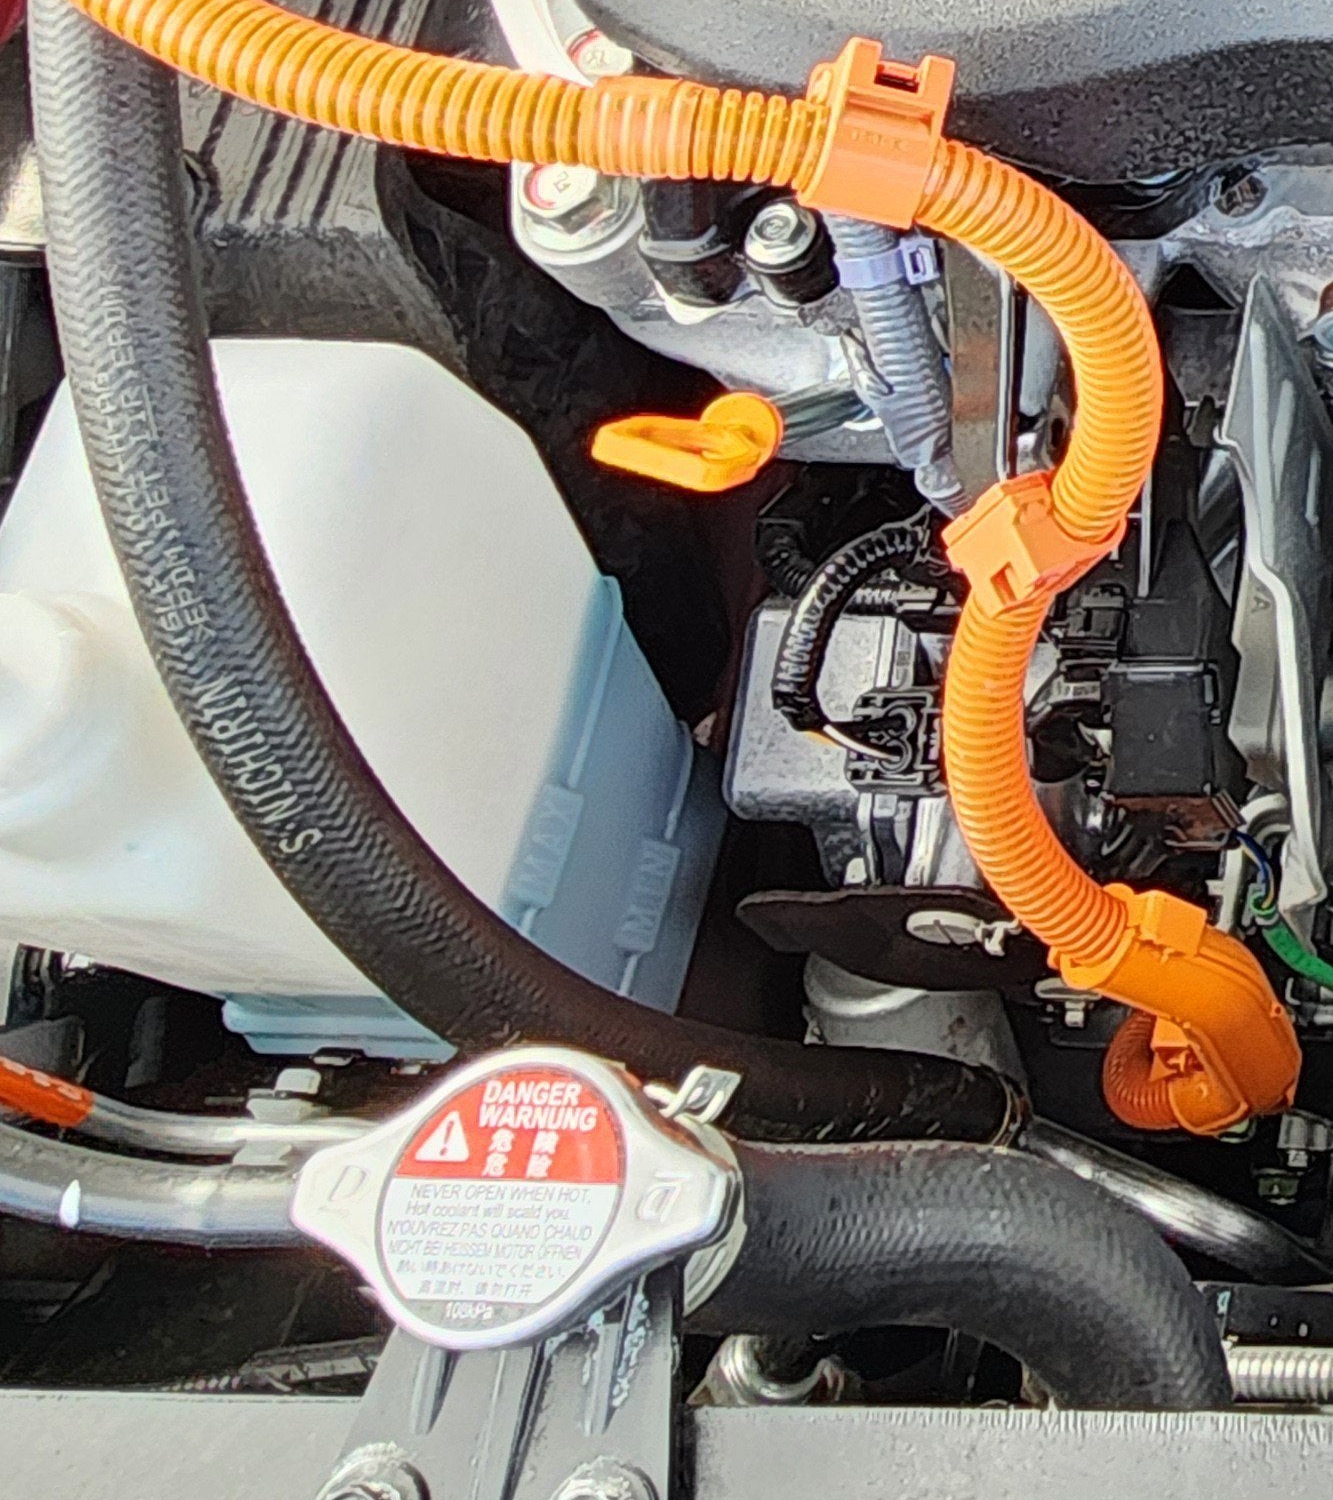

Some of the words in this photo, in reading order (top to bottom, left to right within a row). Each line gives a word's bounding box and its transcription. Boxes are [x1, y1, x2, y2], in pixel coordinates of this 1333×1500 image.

[483, 1080, 582, 1106] DANGER
[478, 1103, 599, 1132] WARNUNG
[411, 1183, 461, 1200] NEVER
[465, 1185, 505, 1201] OPEN
[510, 1186, 555, 1203] WHEN
[405, 1200, 431, 1216] Hot
[433, 1202, 480, 1217] coolant
[484, 1203, 504, 1218] will
[507, 1205, 542, 1220] scald
[461, 1222, 488, 1238] PAS
[491, 1224, 540, 1240] QUAND
[544, 1225, 593, 1242] CHAUD
